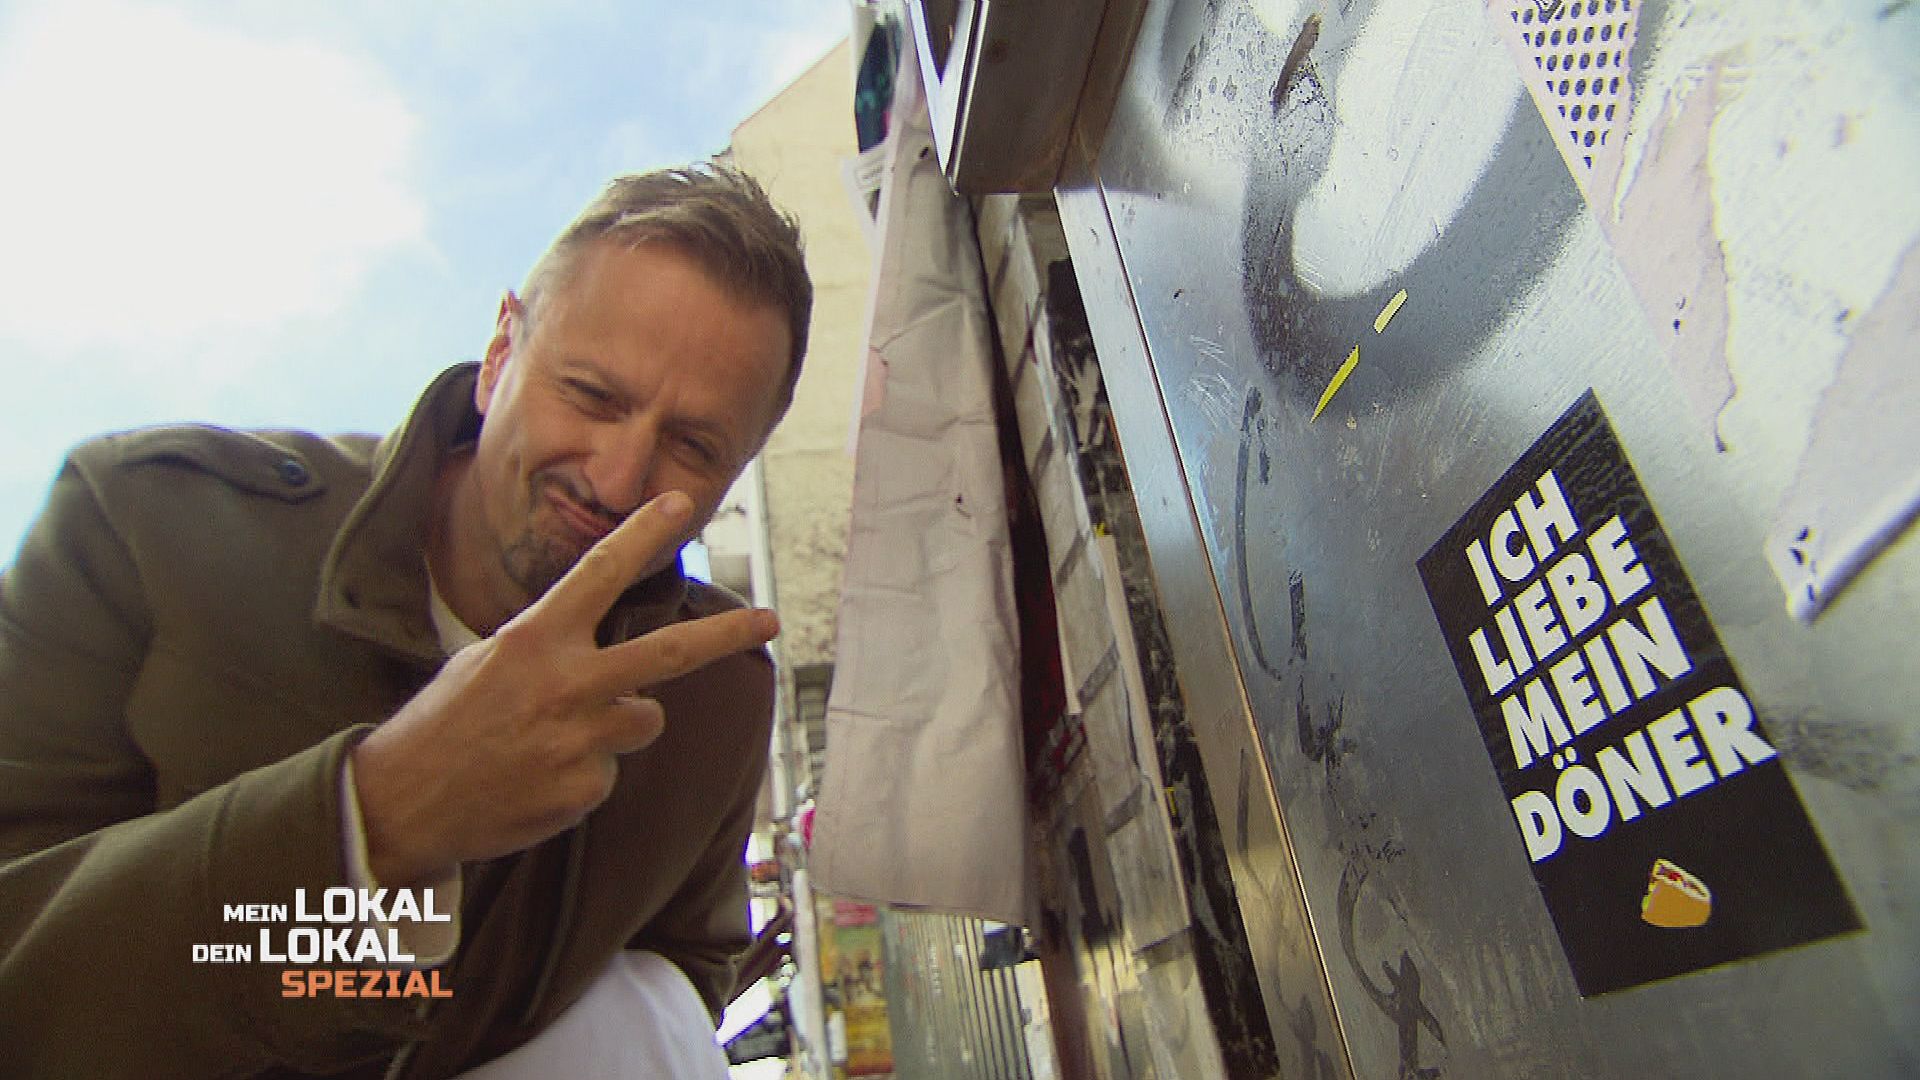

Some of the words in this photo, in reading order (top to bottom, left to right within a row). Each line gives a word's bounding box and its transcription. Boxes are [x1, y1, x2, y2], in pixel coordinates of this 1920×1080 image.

[1466, 469, 1580, 605] ICH
[1469, 515, 1652, 696] LIEBE
[1501, 598, 1693, 770] MEIN
[1512, 686, 1778, 862] DÖNER
